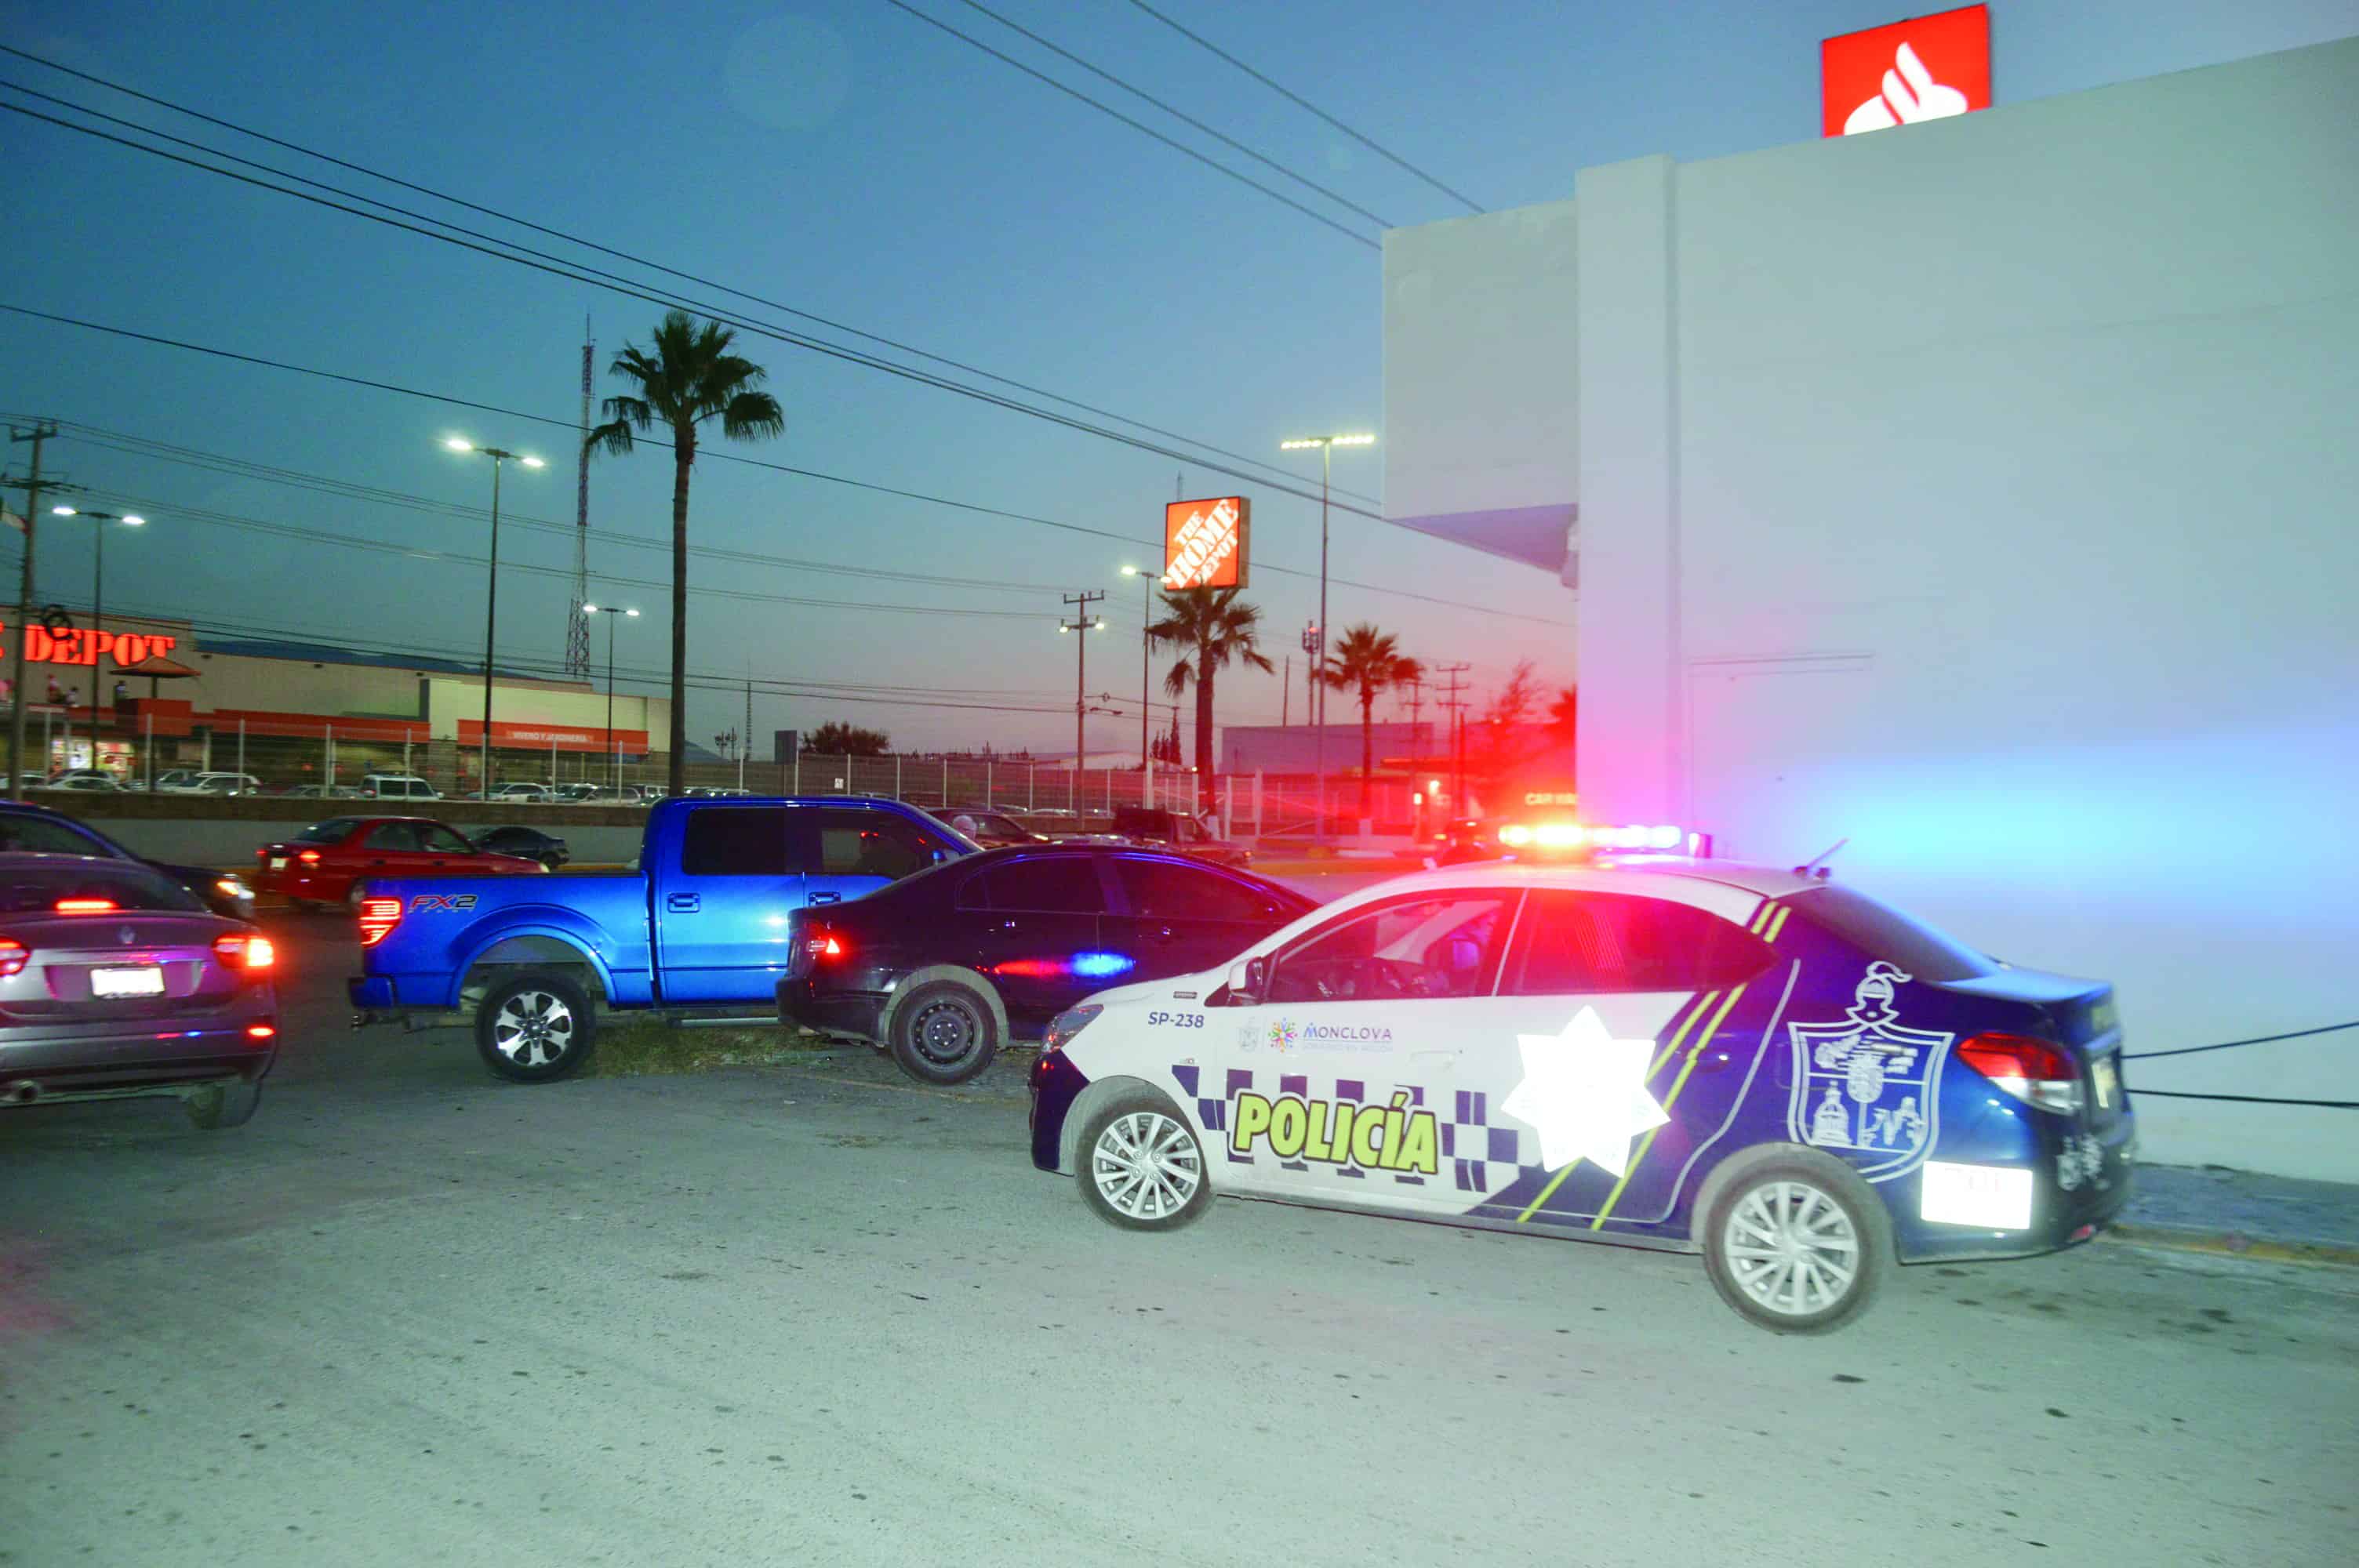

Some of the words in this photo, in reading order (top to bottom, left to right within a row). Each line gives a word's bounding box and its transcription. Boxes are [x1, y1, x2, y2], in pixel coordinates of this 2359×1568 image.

[1165, 499, 1238, 588] HOME
[1174, 510, 1205, 546] THE
[1193, 529, 1238, 585] DEPOT
[25, 624, 176, 666] DEPOT
[411, 894, 478, 909] FX2
[1148, 1011, 1205, 1029] SP-238
[1303, 1022, 1393, 1040] MONCLOVA
[1233, 1091, 1438, 1174] POLICÍA
